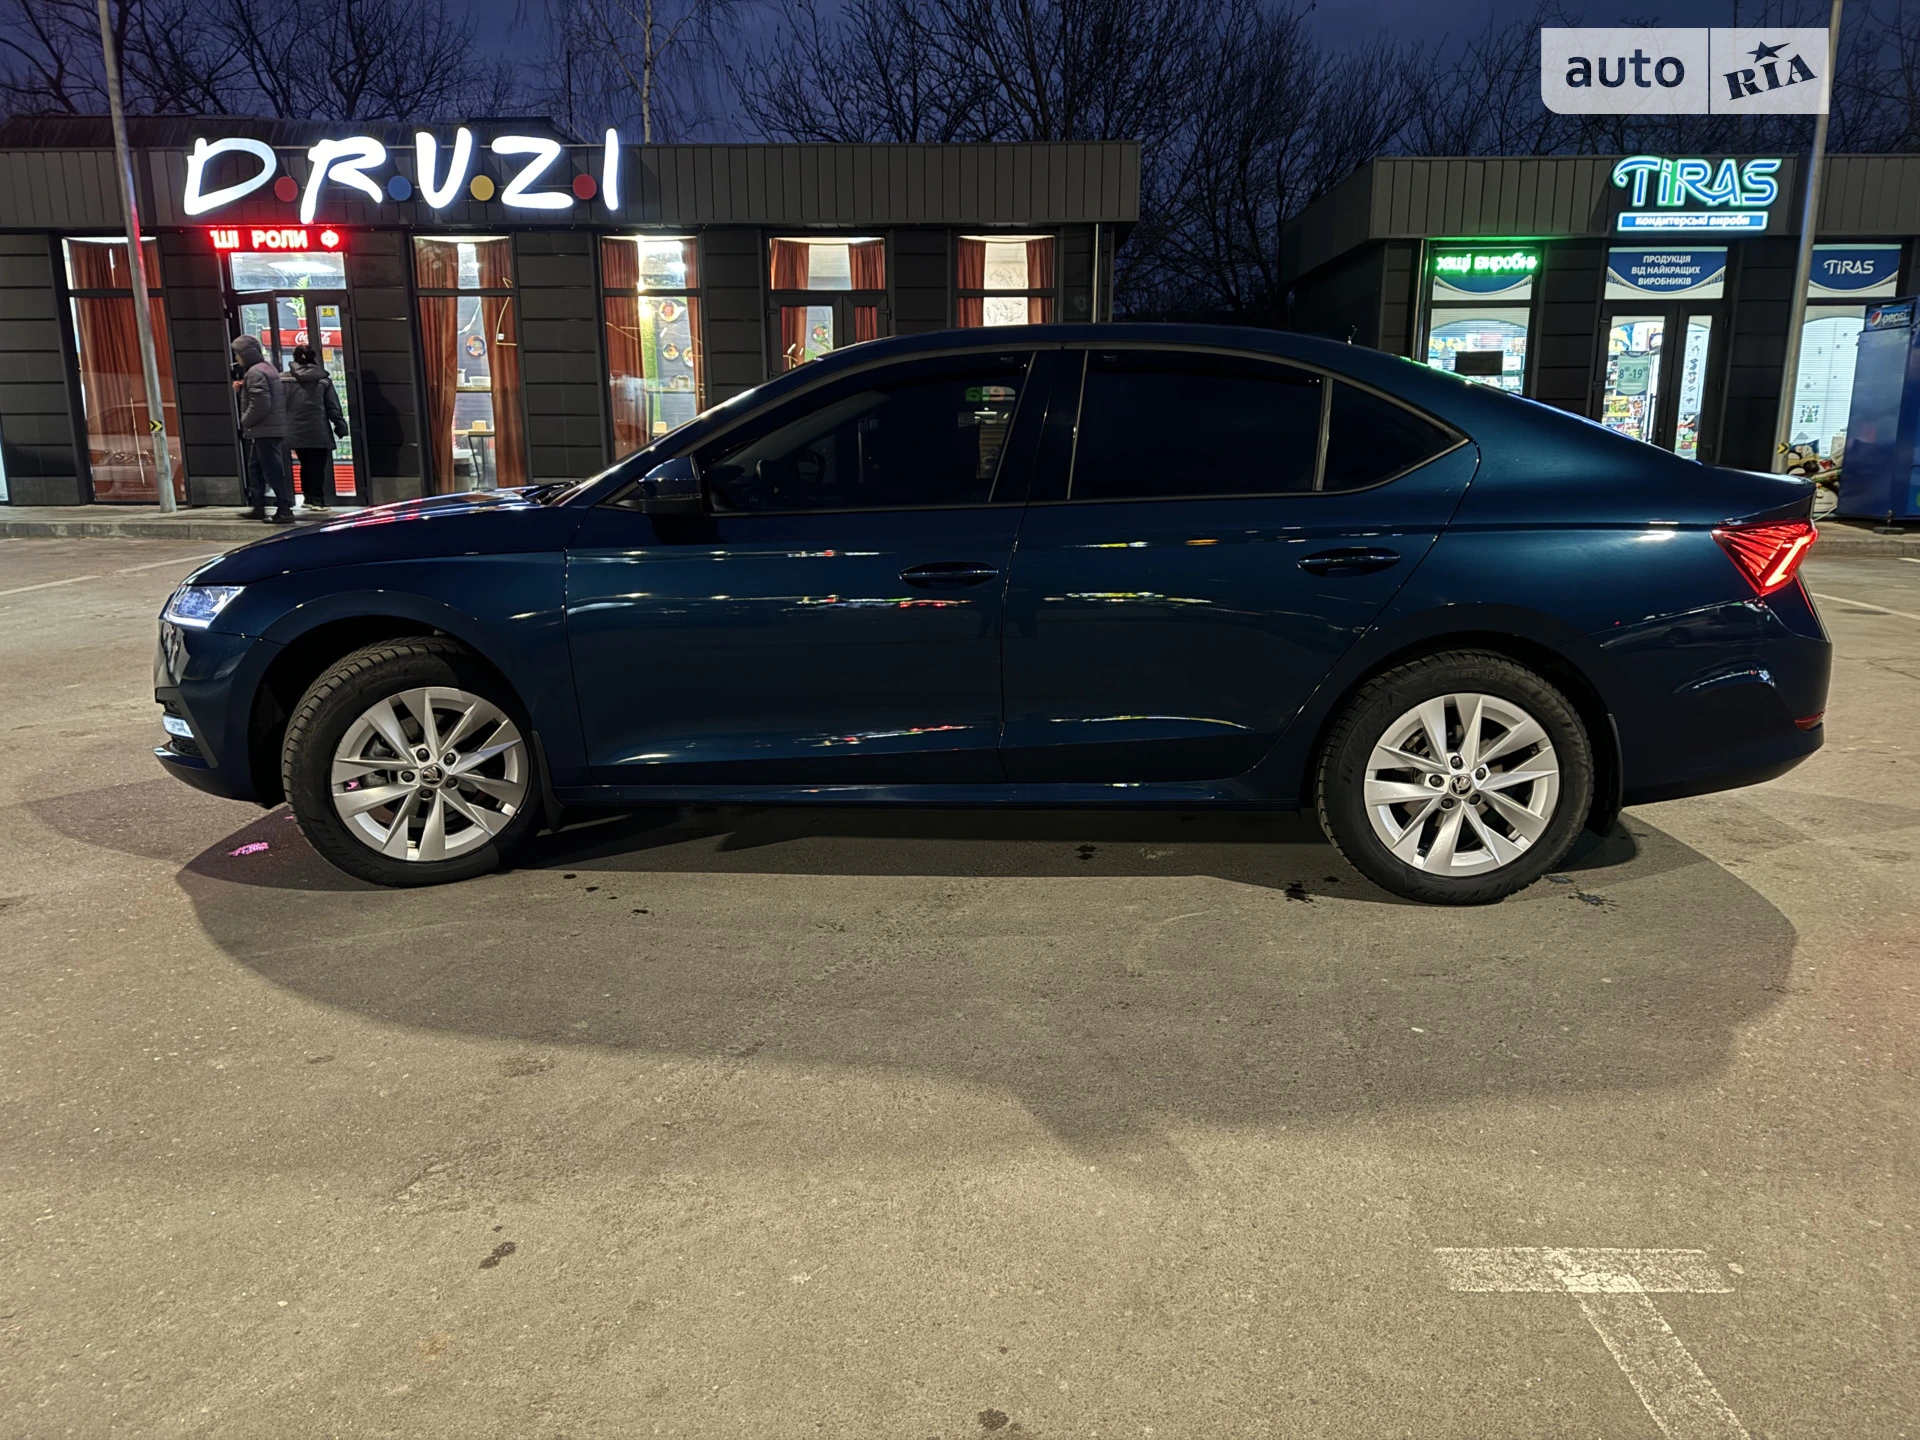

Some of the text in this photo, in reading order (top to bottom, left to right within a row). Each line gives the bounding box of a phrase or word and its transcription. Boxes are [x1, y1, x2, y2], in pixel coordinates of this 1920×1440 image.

[1635, 215, 1750, 227] кондитерські вироби
[251, 230, 308, 249] РОЛИ
[1643, 255, 1691, 264] ПРОДУКЦІЯ
[1631, 265, 1701, 276] ВІД НАЙКРАЩИХ
[1638, 277, 1692, 286] ВИРОБНИКІВ
[1881, 309, 1908, 325] pepsi
